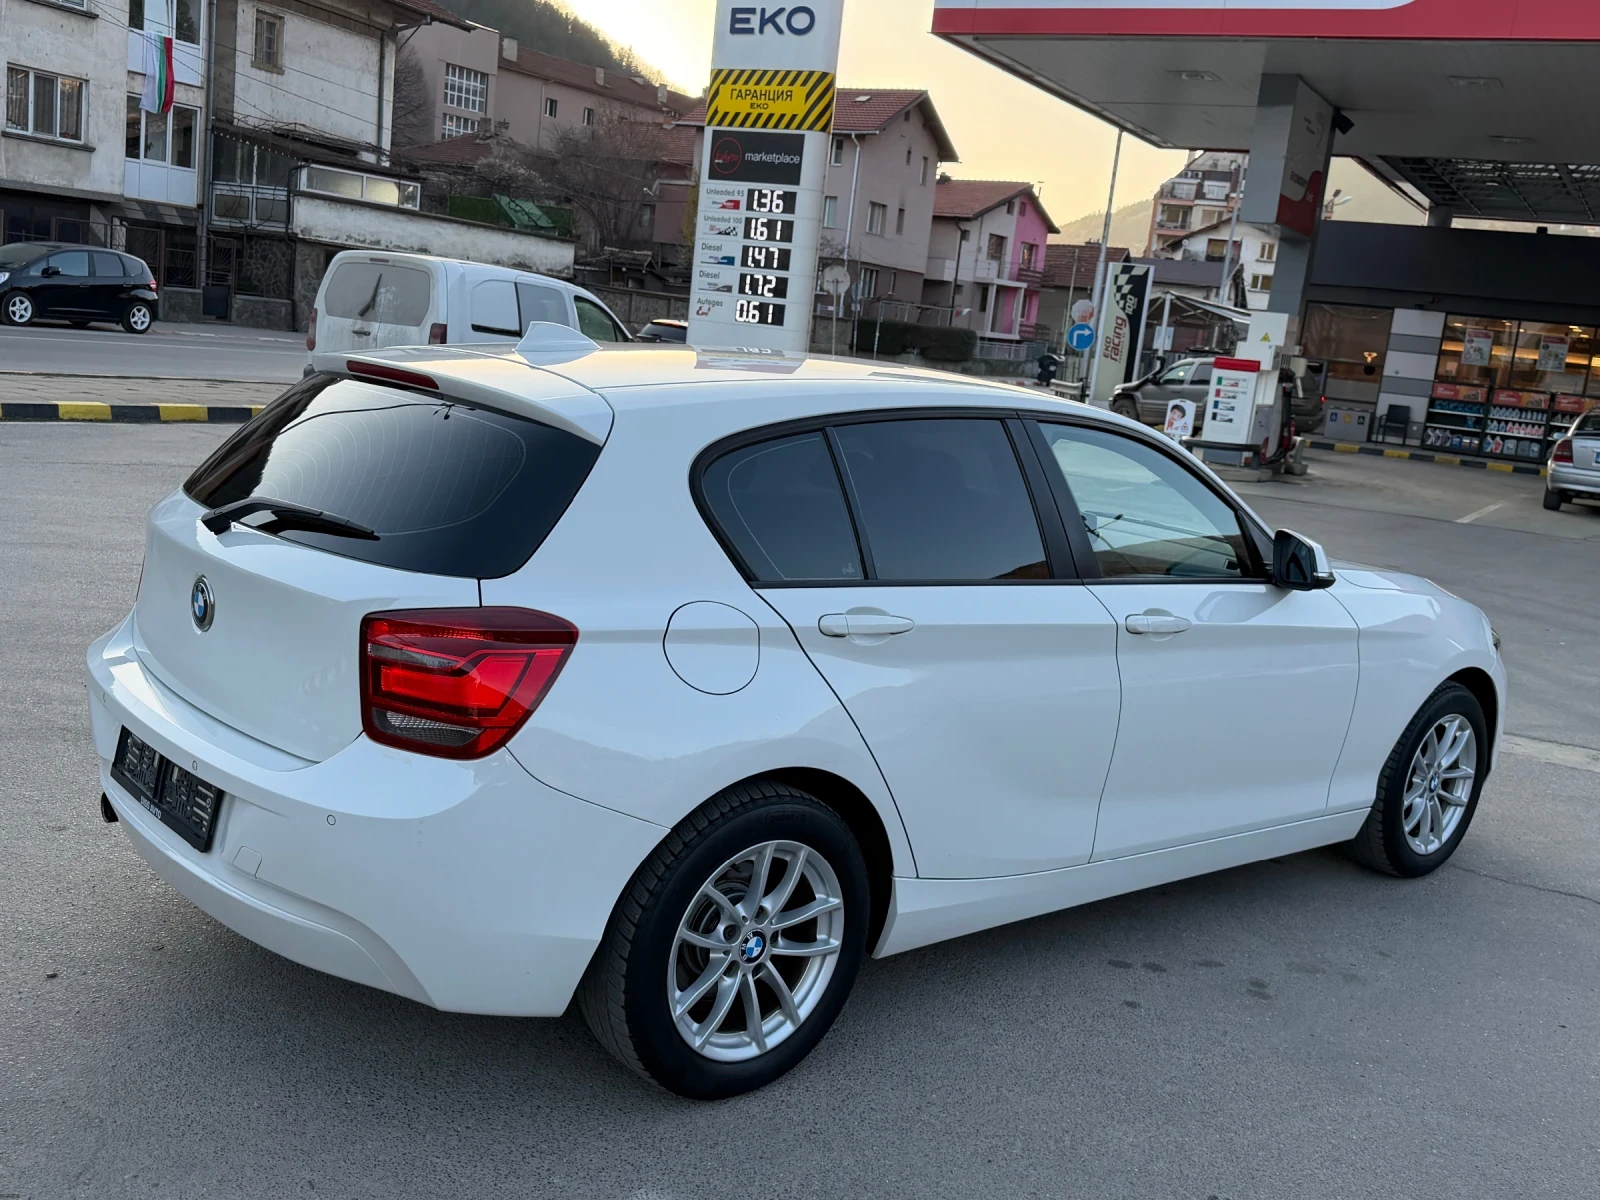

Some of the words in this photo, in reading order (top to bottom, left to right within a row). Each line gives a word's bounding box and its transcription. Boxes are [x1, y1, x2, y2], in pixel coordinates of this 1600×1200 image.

[729, 5, 816, 36] EKO
[730, 88, 793, 103] ГАРАНЦИЯ
[750, 102, 769, 110] EKO
[744, 151, 800, 165] marketplace
[706, 187, 735, 197] Unleaded
[736, 189, 745, 197] 95
[753, 189, 784, 214] 1.36
[703, 215, 731, 224] Unleaded
[732, 217, 743, 225] 100
[750, 217, 782, 241] 1.61
[701, 242, 723, 252] Diesel
[747, 246, 779, 269] 1.47
[698, 270, 720, 280] Diesel
[744, 273, 777, 297] 1.72
[696, 297, 723, 308] Autogas
[735, 299, 774, 324] 0.61
[1124, 294, 1135, 315] 100
[1103, 336, 1112, 359] EKO
[1109, 316, 1127, 362] racing
